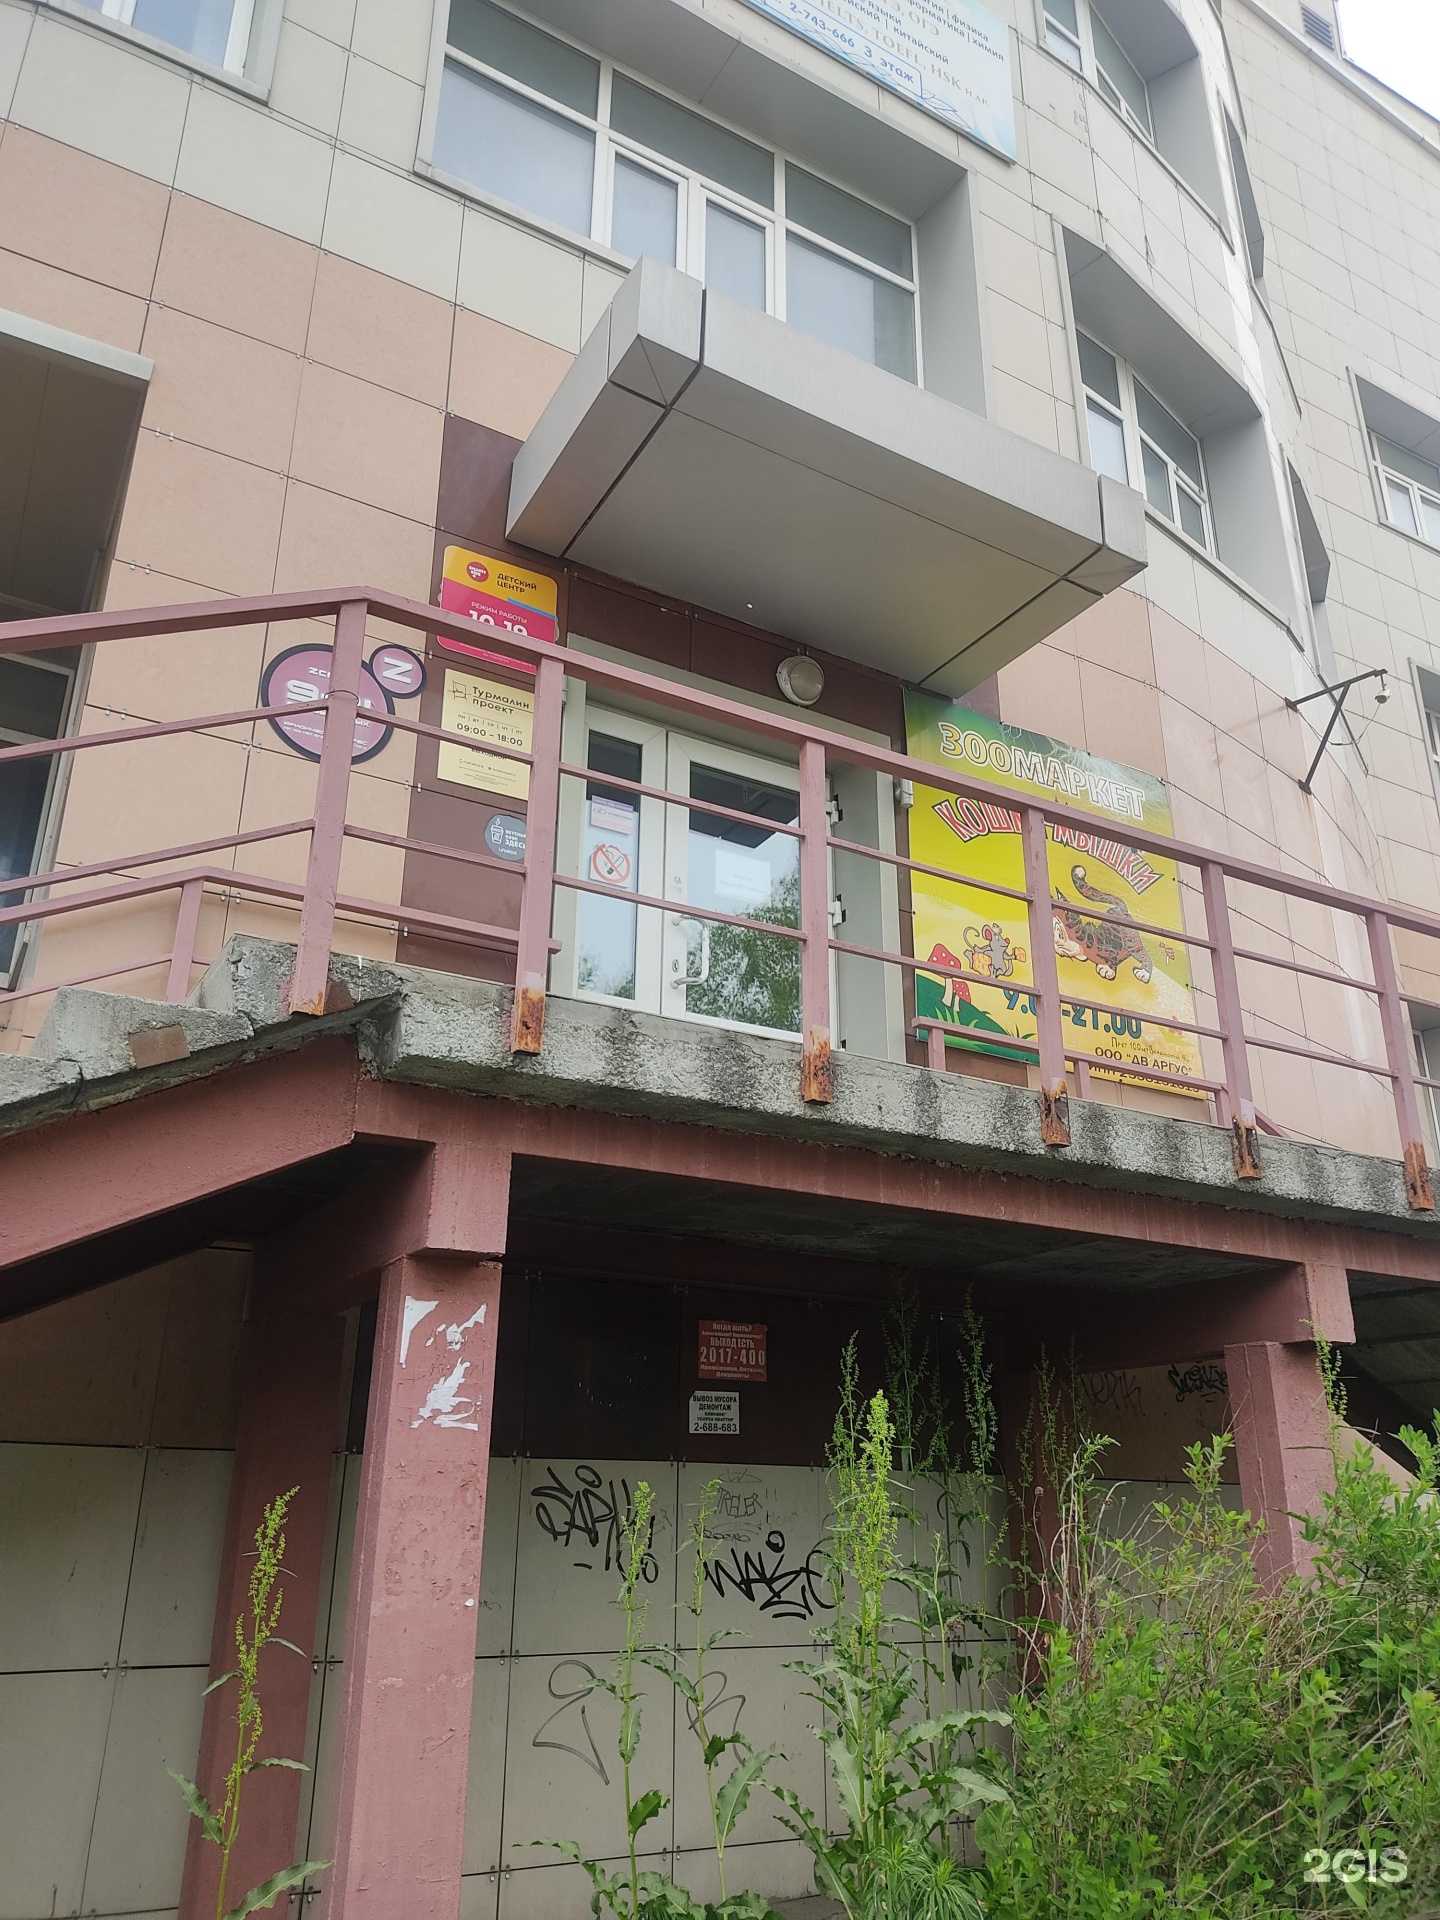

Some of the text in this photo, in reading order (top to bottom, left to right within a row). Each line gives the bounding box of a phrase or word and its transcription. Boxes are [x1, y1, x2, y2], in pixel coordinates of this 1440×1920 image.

[868, 1, 902, 26] языки
[951, 14, 989, 42] физика
[788, 2, 914, 83] 2-743-666 3 этаж
[894, 26, 949, 64] китайский
[972, 38, 1005, 62] химия
[497, 573, 537, 591] ДЕТСКИЙ
[497, 580, 526, 593] ЦЕНТР
[471, 601, 528, 623] РЕЖИМ РАБОТЫ
[472, 698, 515, 715] проект
[473, 686, 530, 710] Турмалин
[456, 722, 487, 737] 09:00
[497, 733, 523, 746] 18:00
[938, 721, 1146, 820] ЗООМАРКЕТ
[1095, 1047, 1122, 1062] ООО
[700, 1346, 765, 1366] 2017-400
